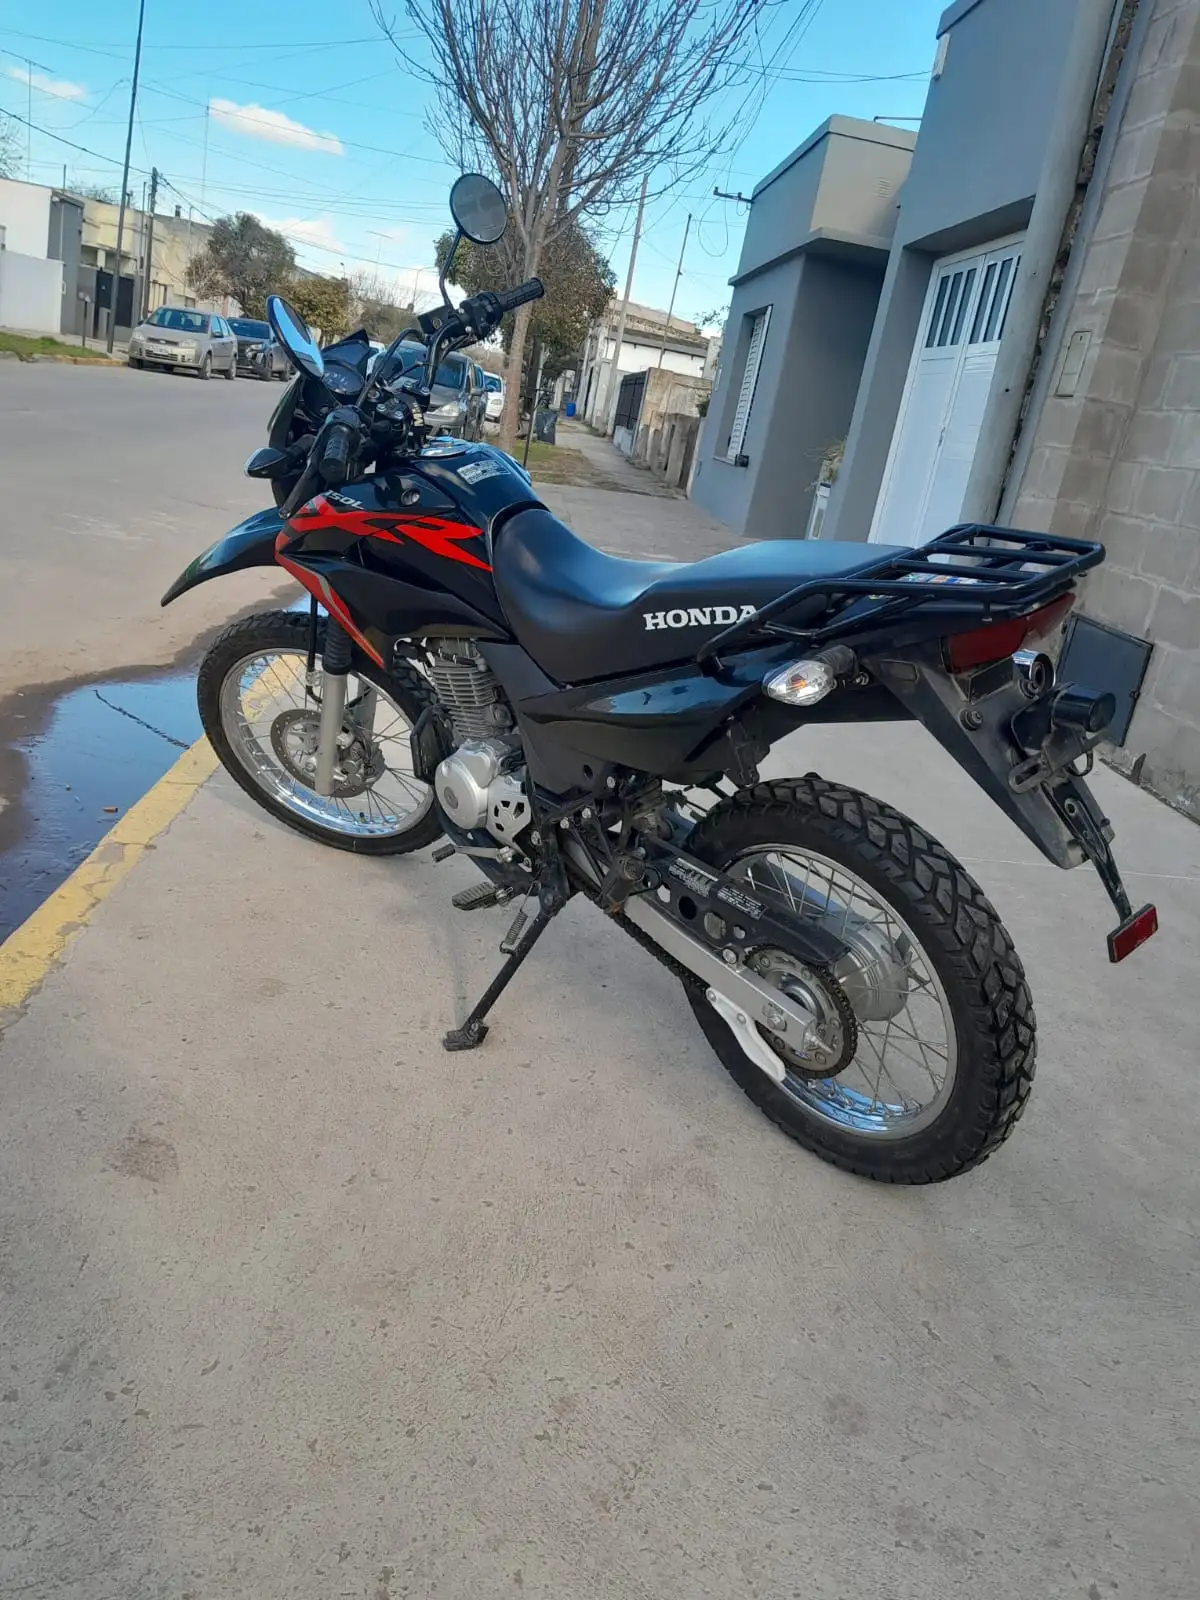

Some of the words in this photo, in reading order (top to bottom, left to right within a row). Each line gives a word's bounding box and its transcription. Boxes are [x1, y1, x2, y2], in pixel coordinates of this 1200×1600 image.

[325, 489, 365, 510] 150L
[288, 495, 493, 572] XR
[643, 605, 757, 630] HONDA
